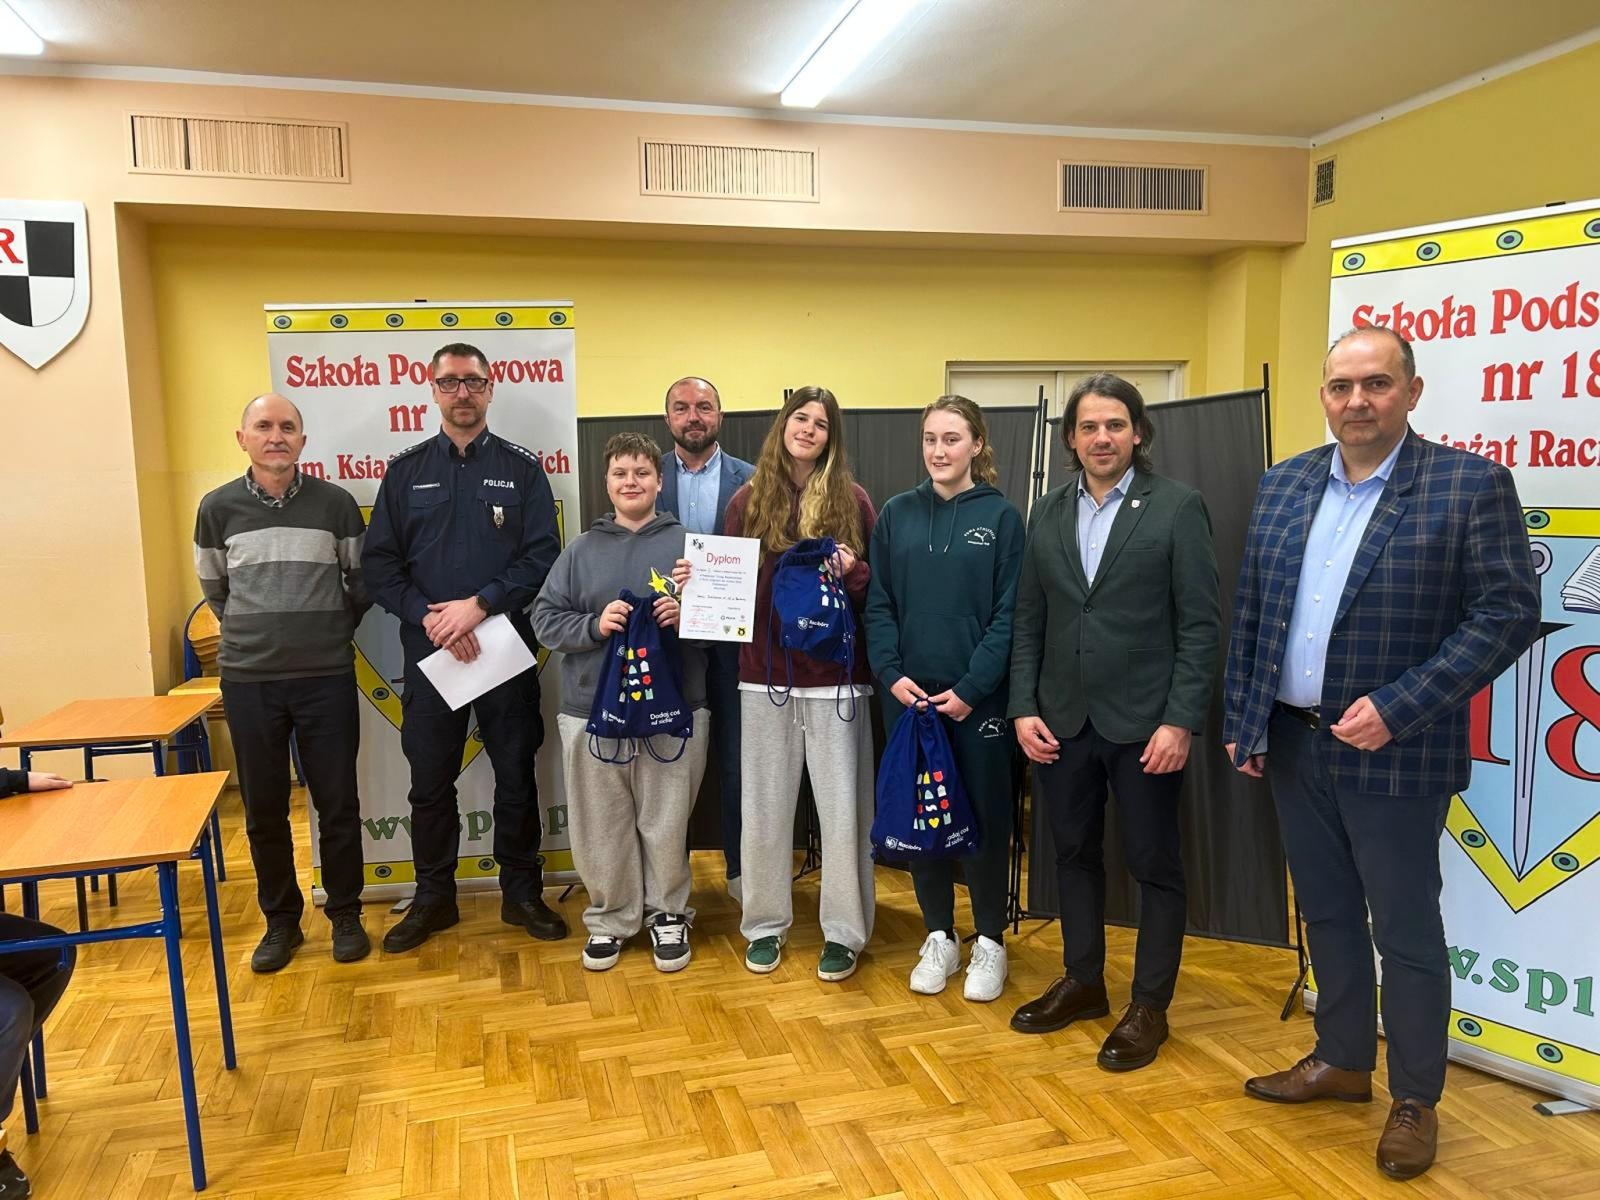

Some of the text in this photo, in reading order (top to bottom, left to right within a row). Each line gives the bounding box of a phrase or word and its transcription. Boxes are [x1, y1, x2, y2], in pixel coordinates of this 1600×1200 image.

[286, 354, 381, 388] Szkoła
[1481, 360, 1544, 402] nr
[388, 403, 428, 433] nr
[483, 479, 515, 489] POLICJA
[706, 552, 741, 566] Dyplom
